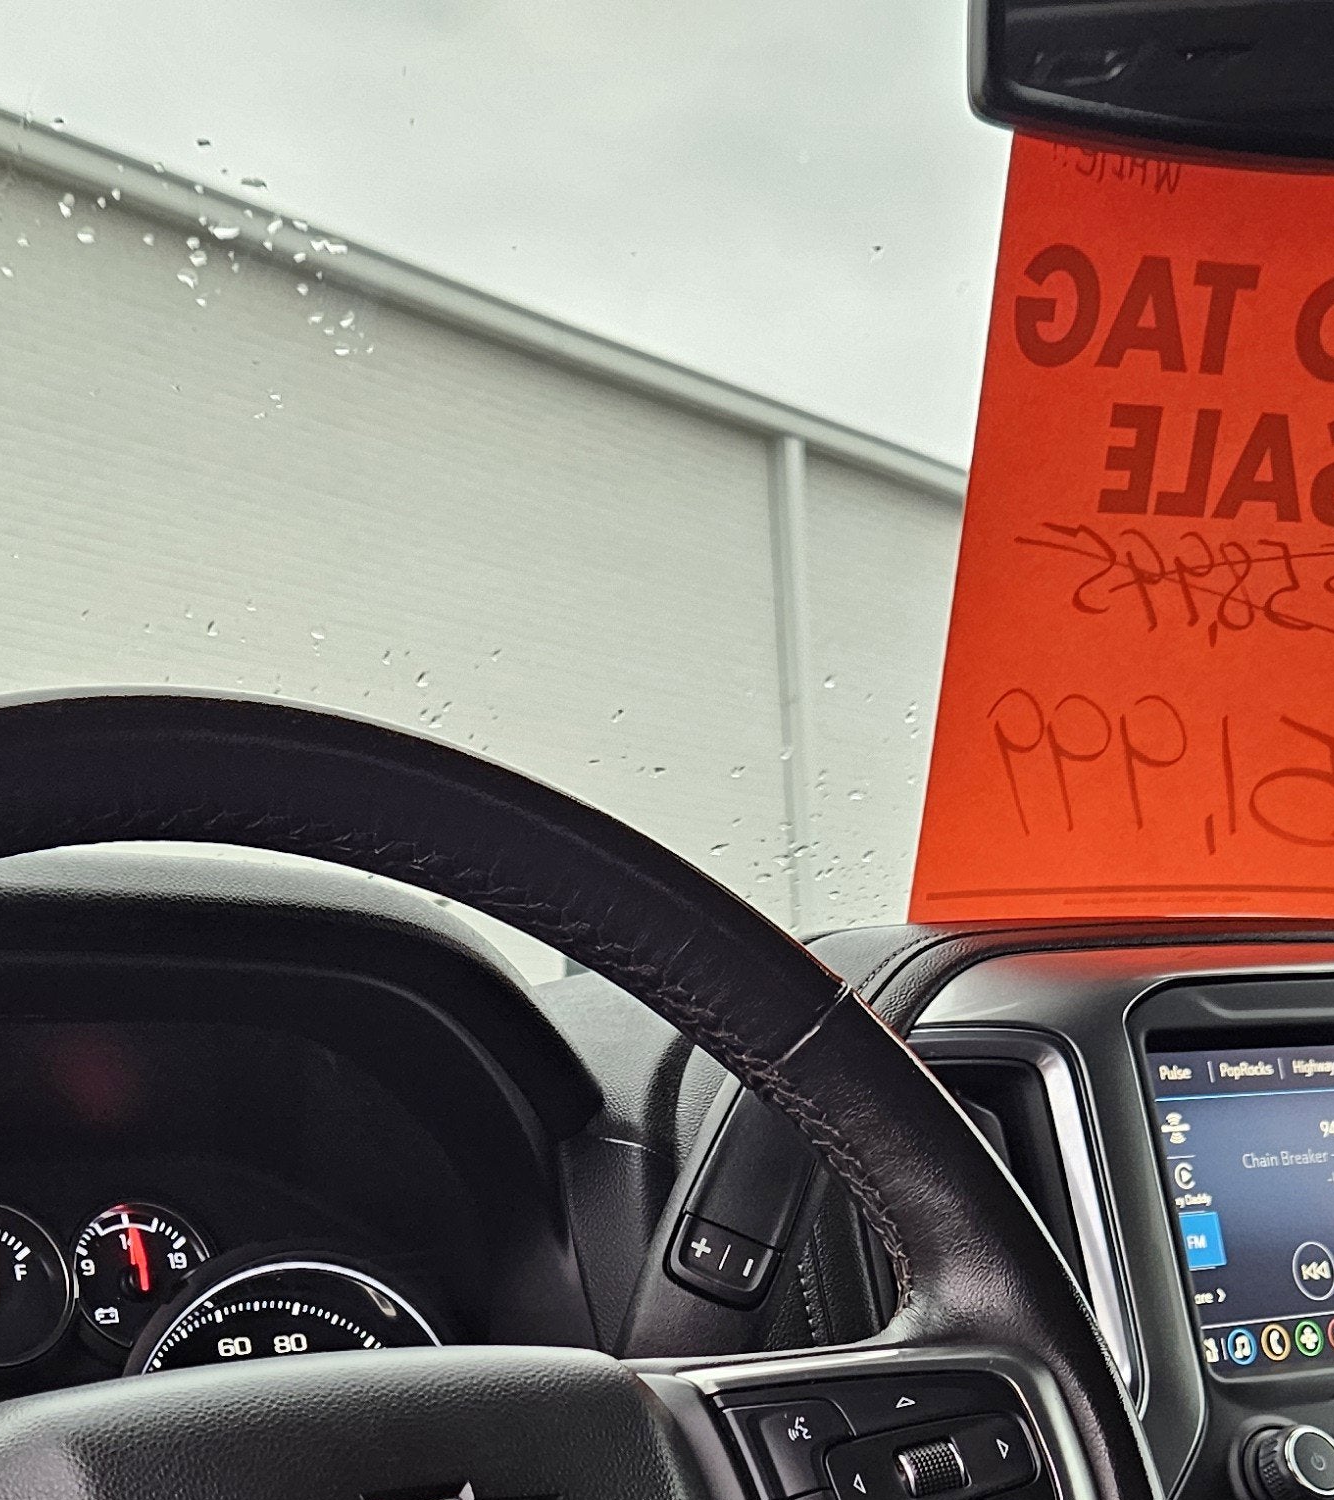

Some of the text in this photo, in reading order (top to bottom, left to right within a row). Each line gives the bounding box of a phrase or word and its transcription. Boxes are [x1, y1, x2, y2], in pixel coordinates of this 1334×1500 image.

[1242, 1151, 1278, 1170] Chain
[1280, 1148, 1329, 1167] Breaker
[80, 1259, 97, 1277] 9
[167, 1252, 188, 1270] 19
[15, 1264, 29, 1282] F
[217, 1333, 308, 1357] 60 80
